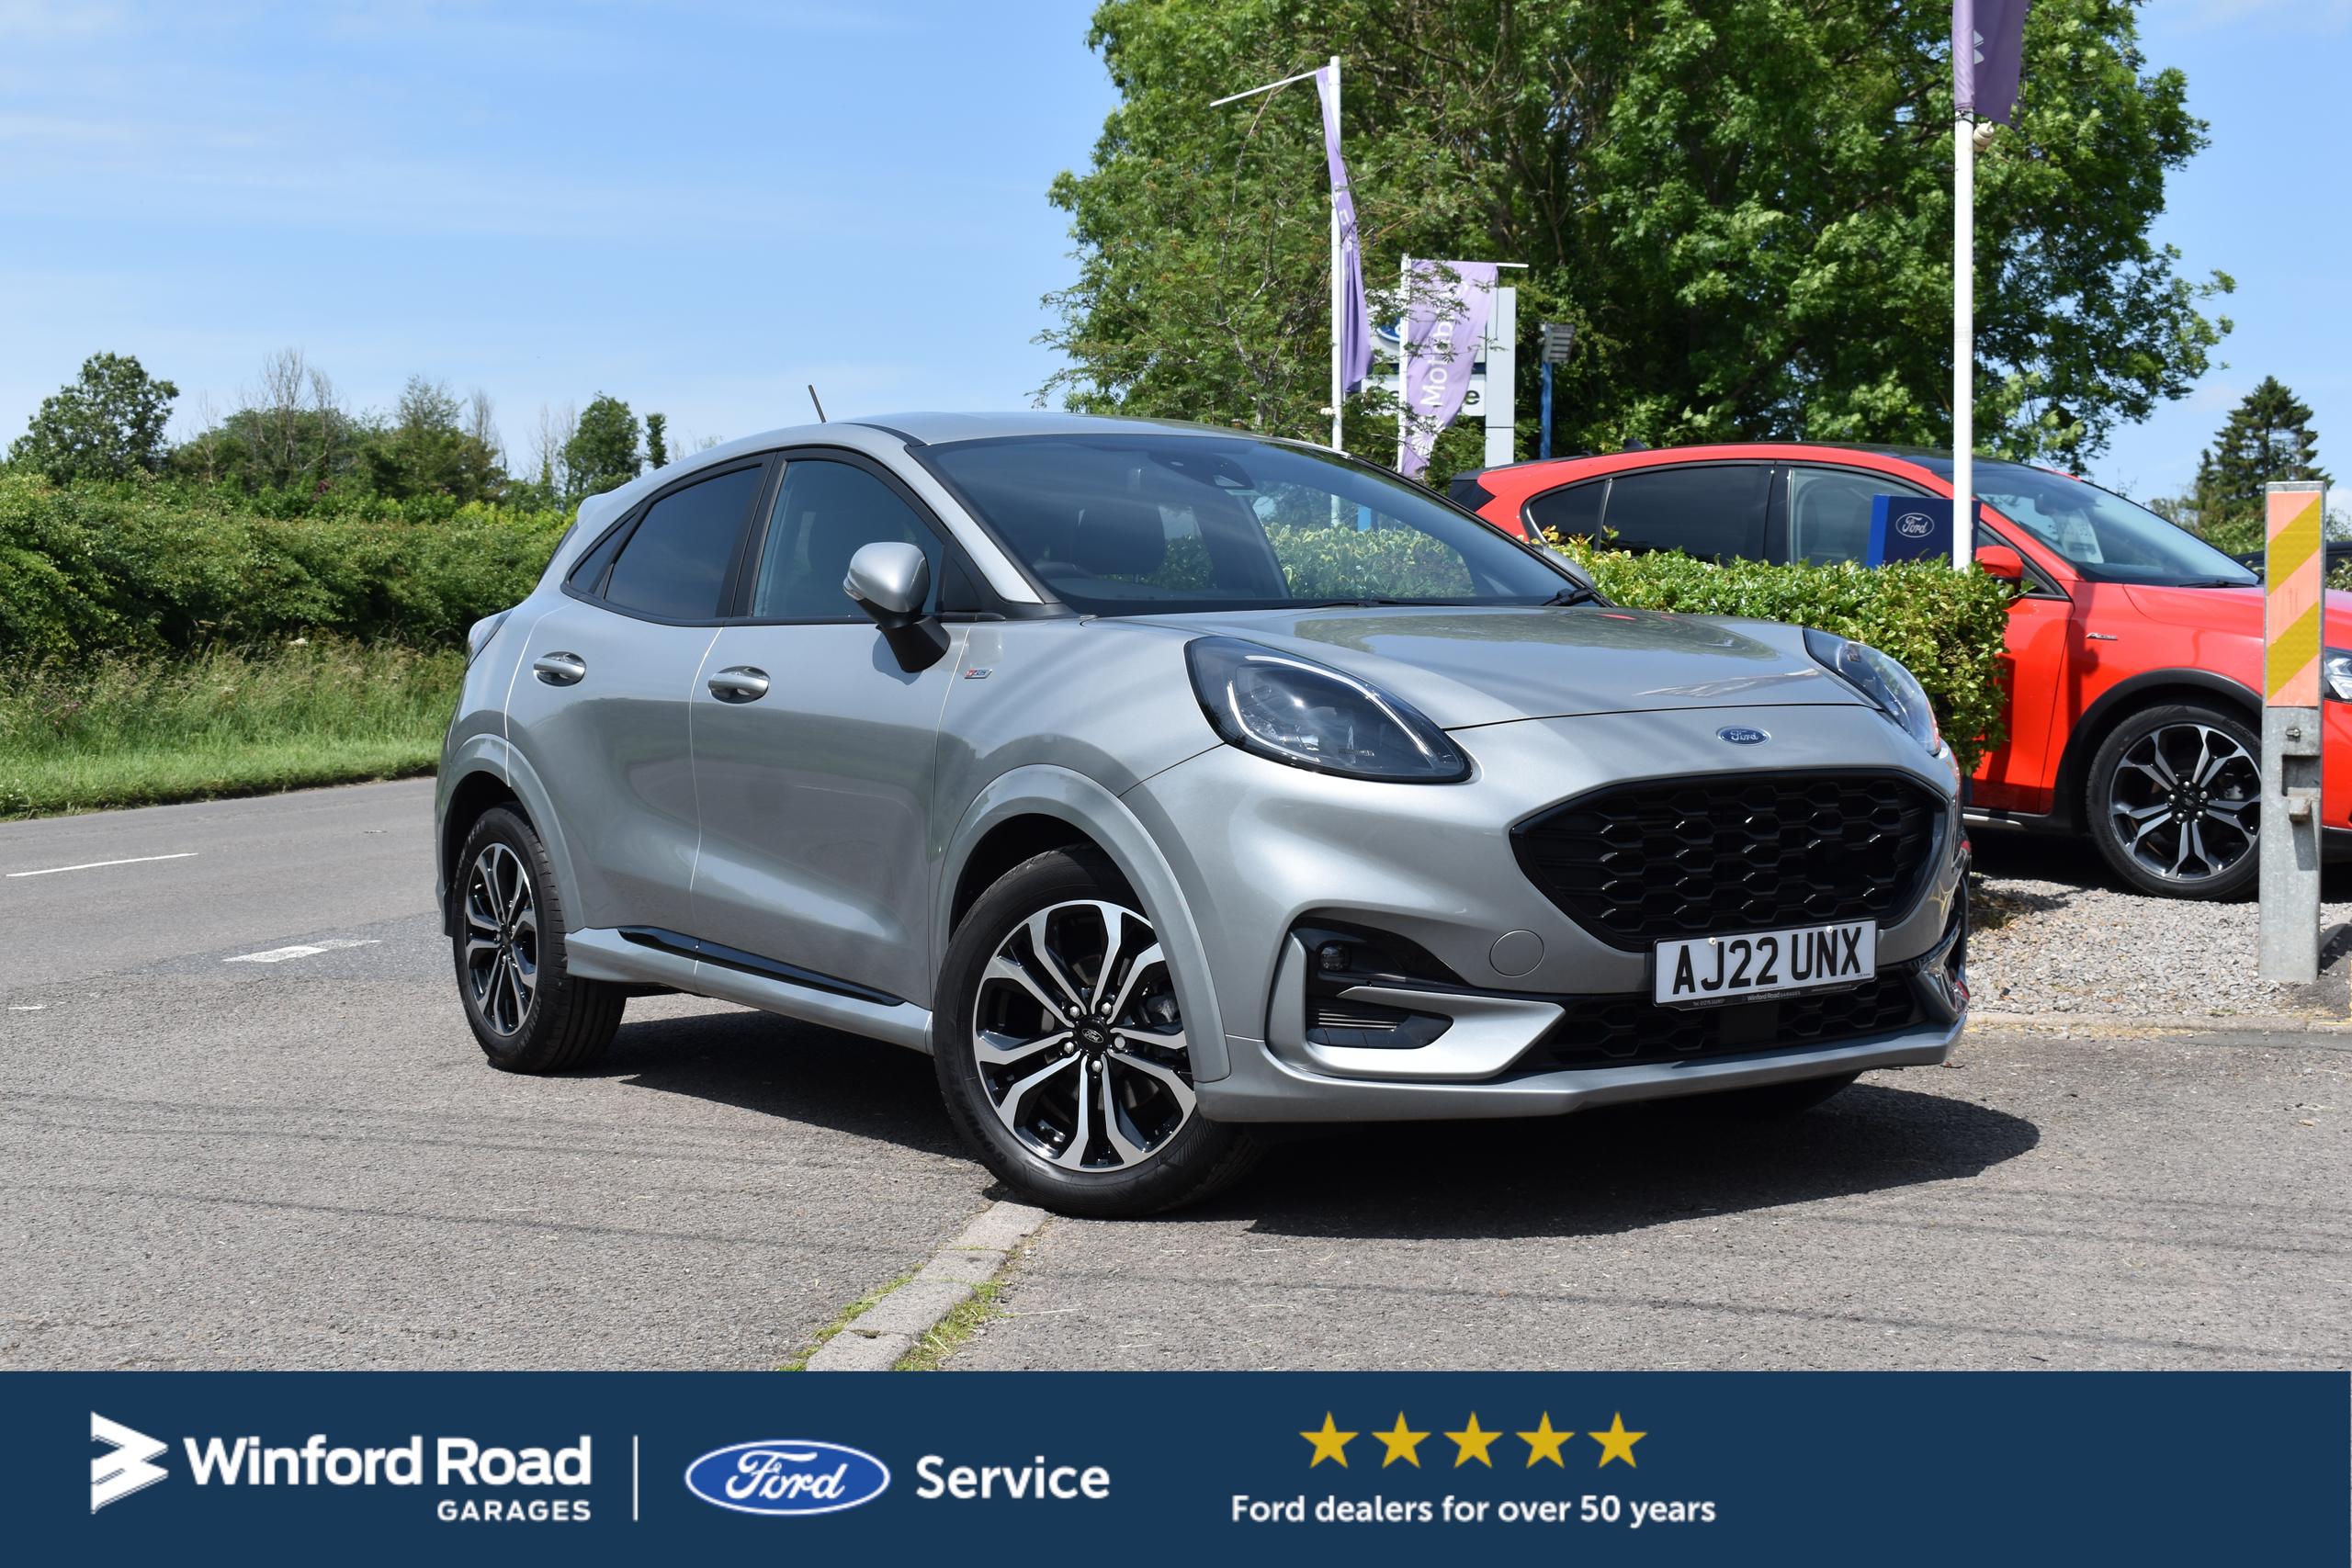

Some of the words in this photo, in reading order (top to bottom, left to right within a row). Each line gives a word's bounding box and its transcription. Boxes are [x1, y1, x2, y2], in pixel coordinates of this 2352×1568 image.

[1902, 515, 1928, 533] Ford
[1730, 730, 1758, 740] Ford
[1672, 936, 1779, 995] AJ22
[1792, 926, 1862, 981] UNX
